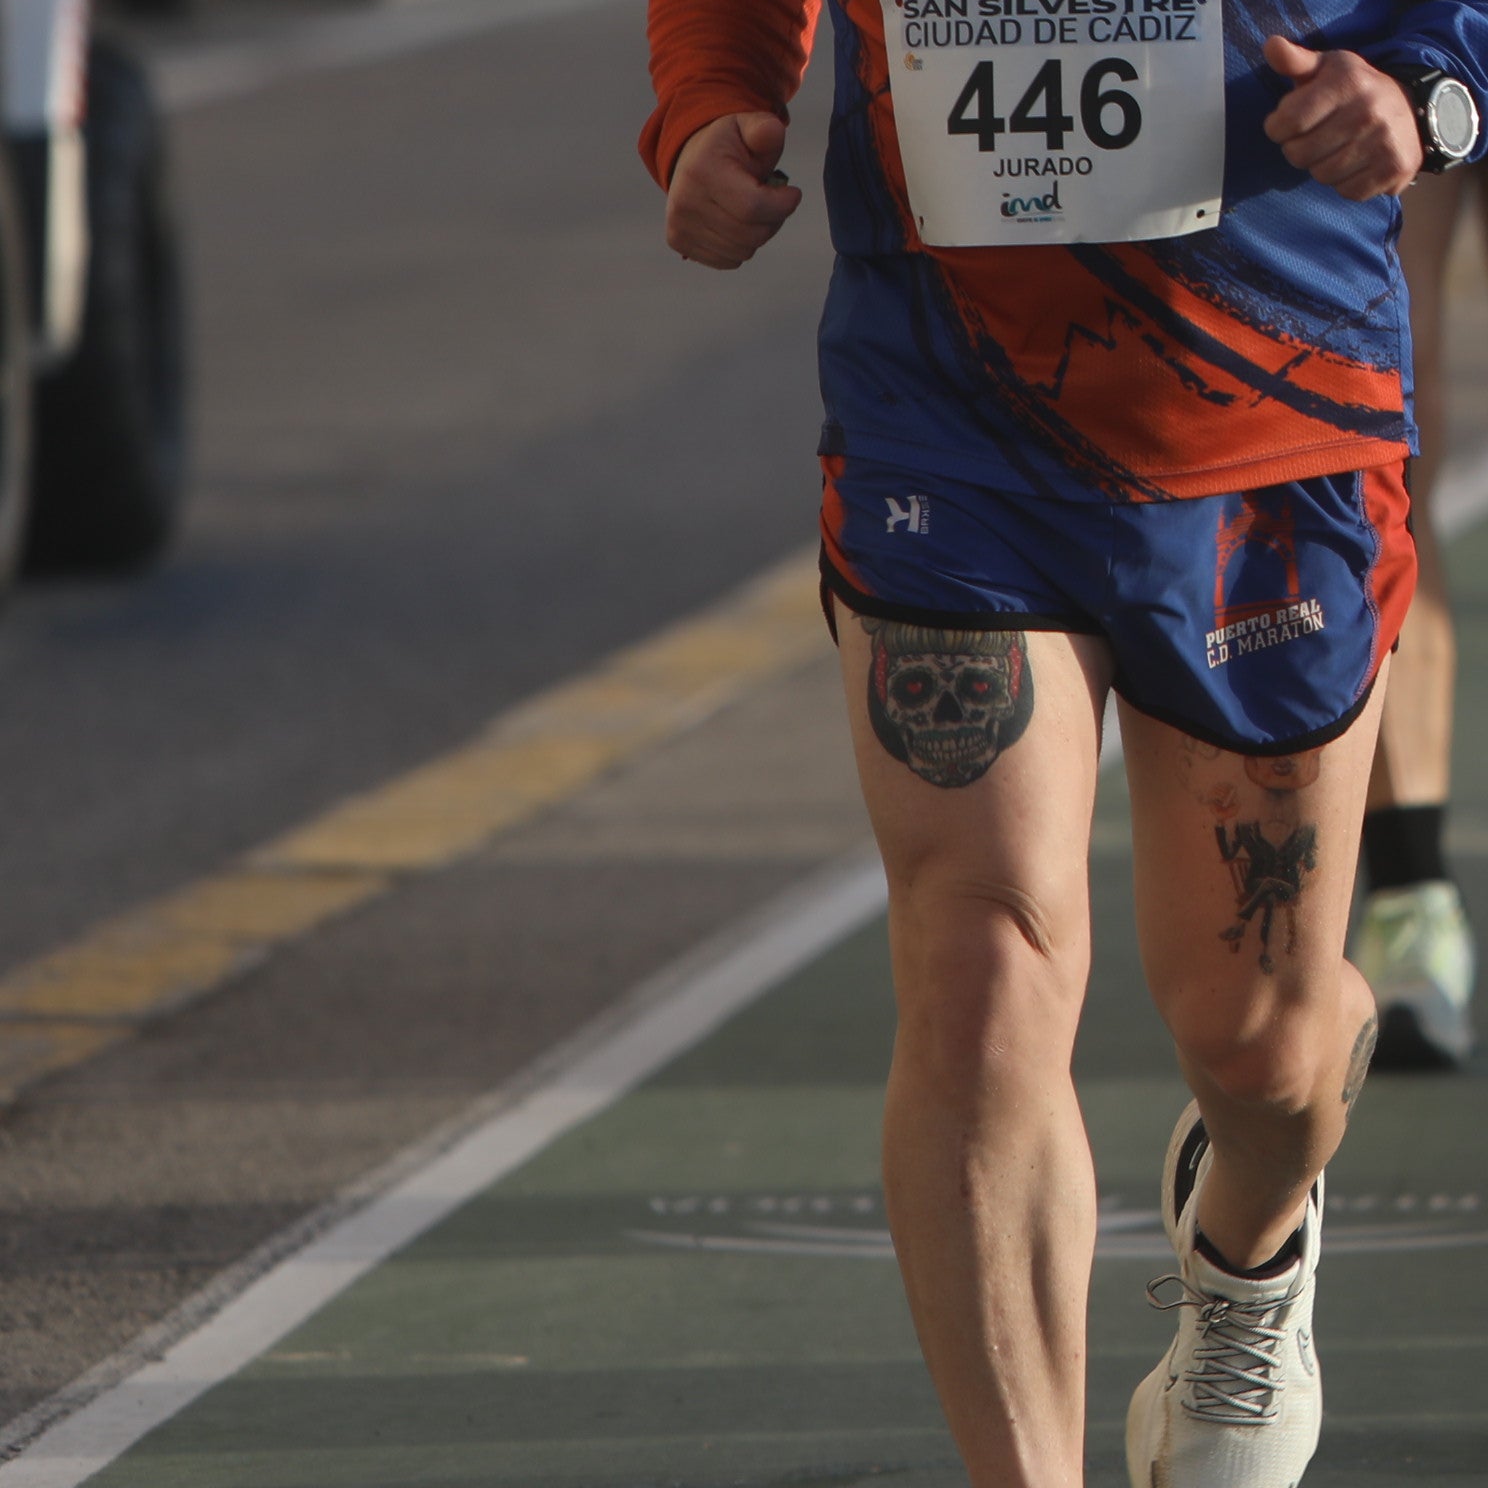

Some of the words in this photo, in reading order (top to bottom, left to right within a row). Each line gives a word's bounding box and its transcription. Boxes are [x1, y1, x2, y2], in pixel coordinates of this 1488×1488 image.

[904, 18, 1022, 48] CIUDAD
[1033, 17, 1078, 44] DE
[947, 57, 1142, 152] 446
[993, 157, 1093, 178] JURADO
[1205, 613, 1271, 649] PUERTO
[1276, 598, 1321, 625] REAL
[1206, 643, 1233, 669] C.D.
[1237, 611, 1325, 656] MARATON
